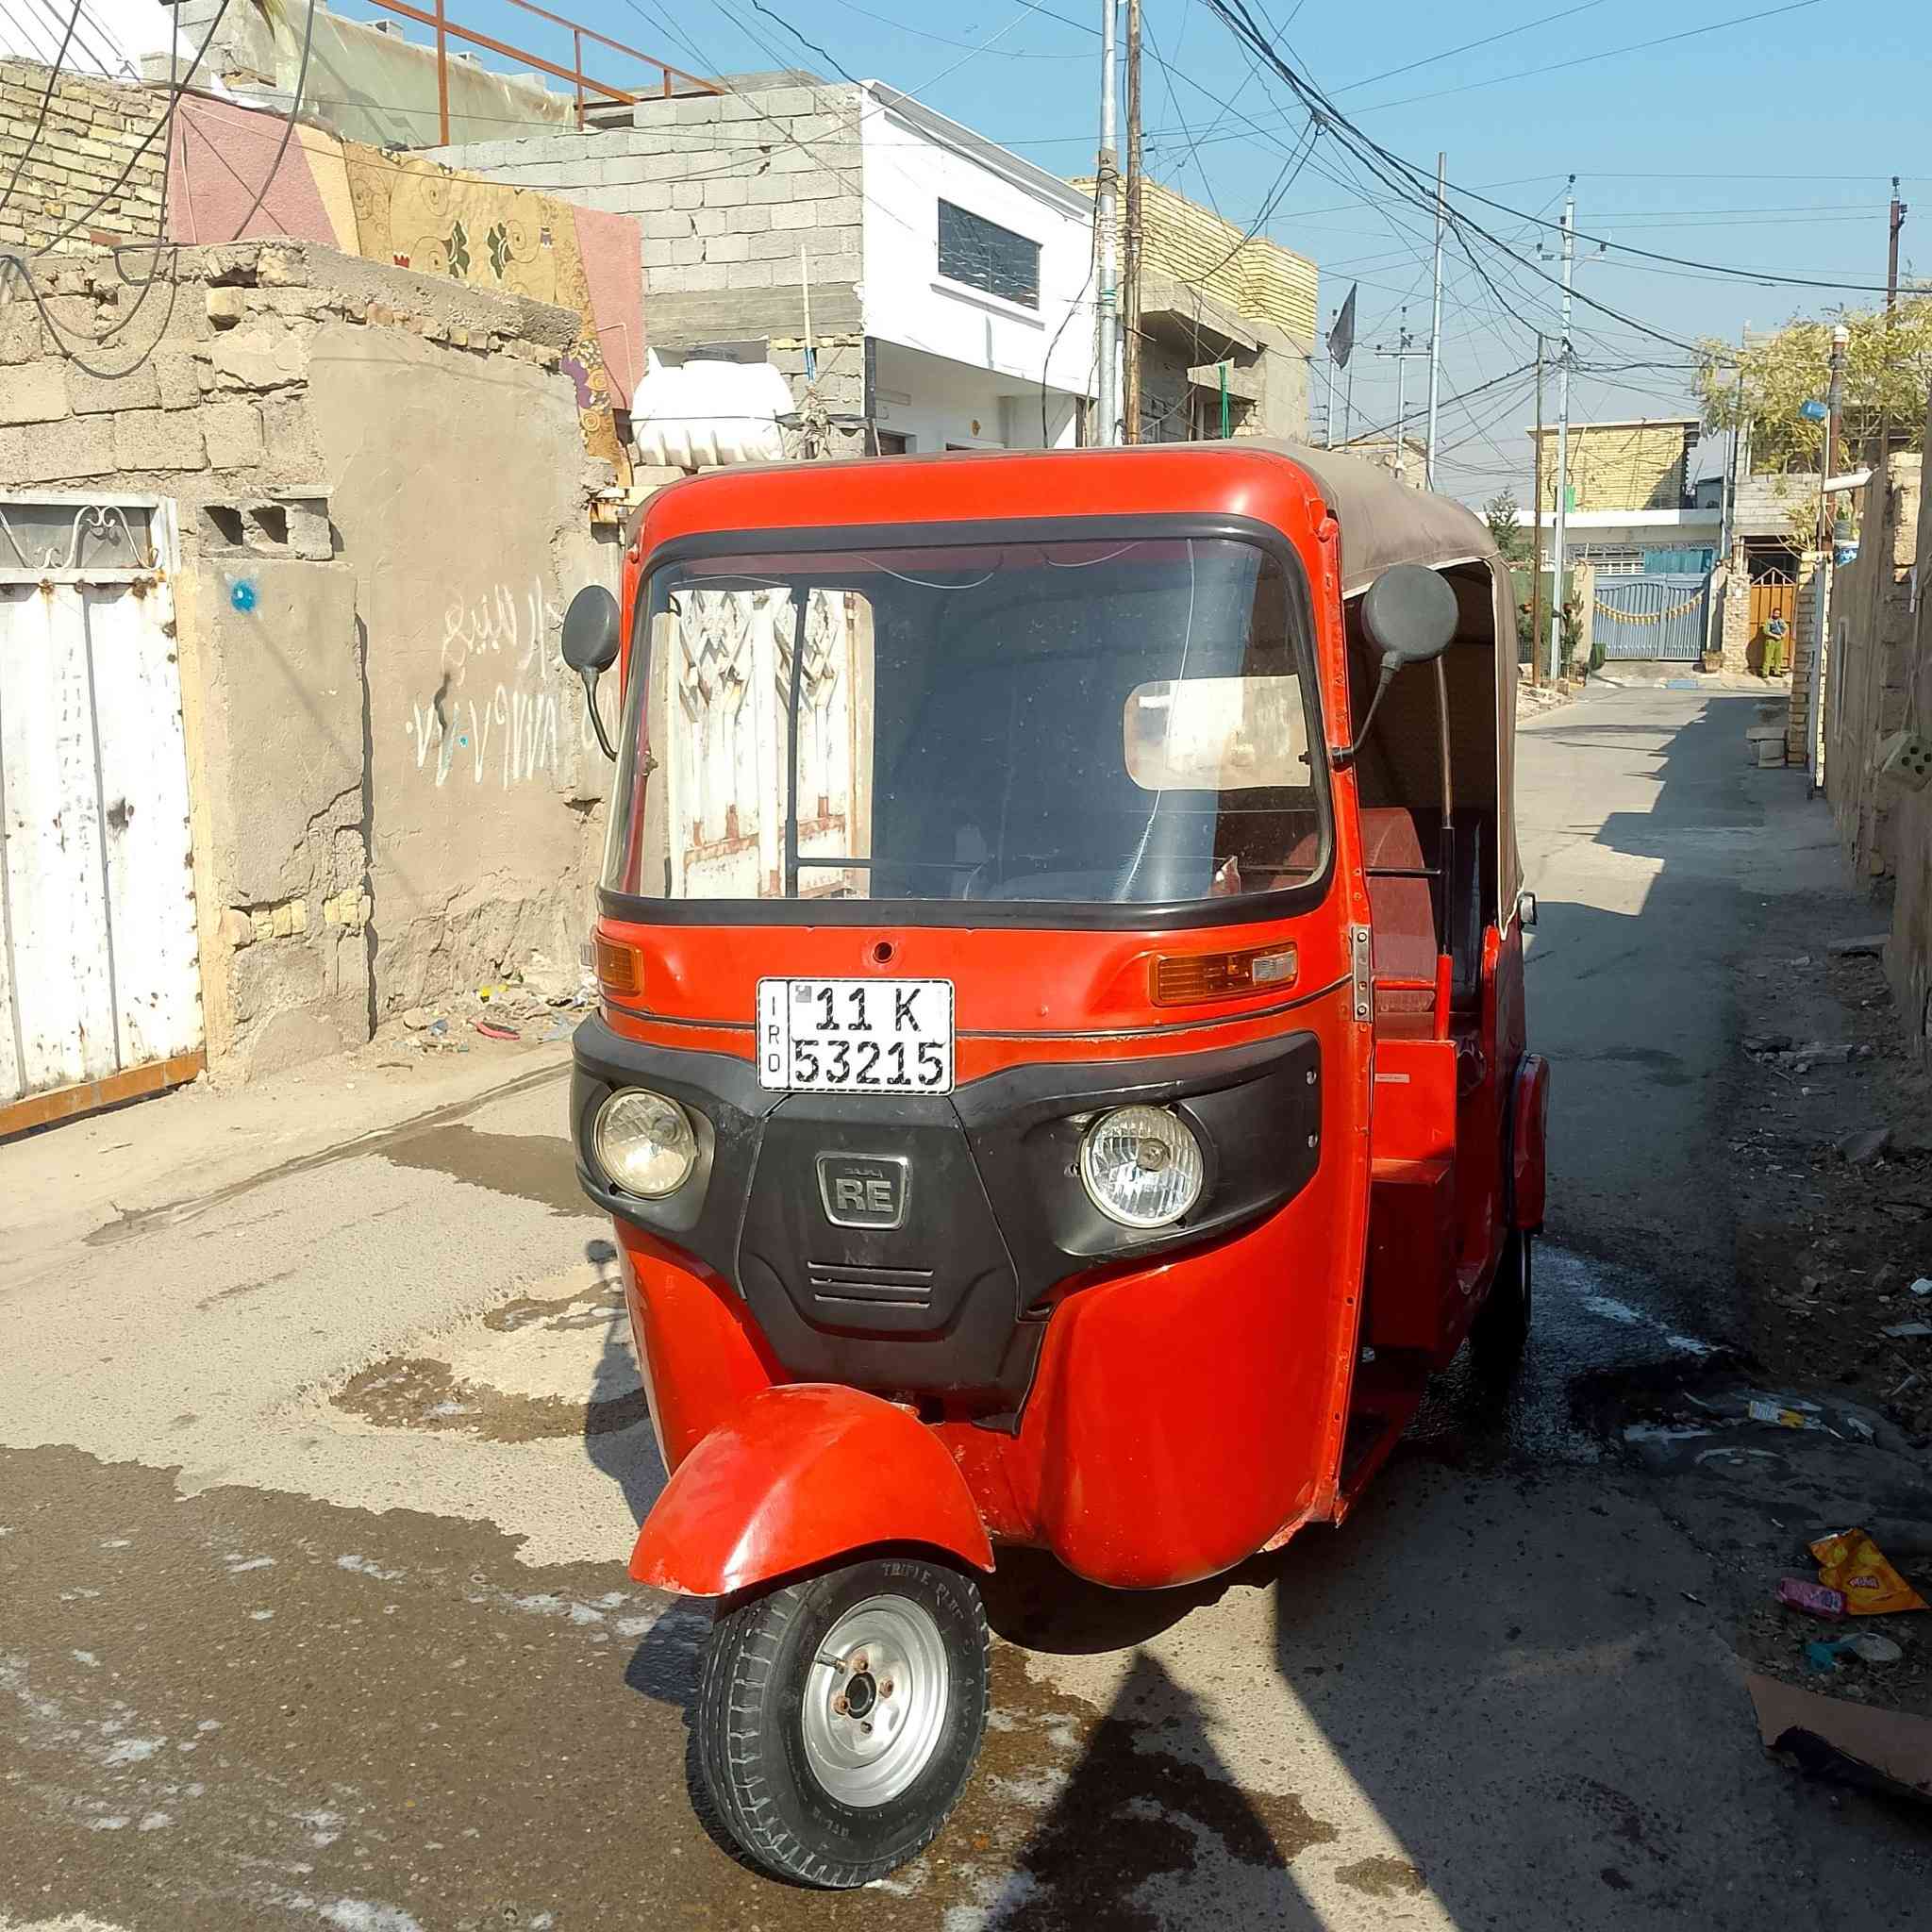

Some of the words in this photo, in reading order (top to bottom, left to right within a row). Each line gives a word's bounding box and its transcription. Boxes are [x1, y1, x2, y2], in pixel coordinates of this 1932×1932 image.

[815, 987, 873, 1031] 11
[894, 988, 922, 1032] K
[794, 1039, 944, 1086] 53215
[835, 1178, 894, 1212] RE
